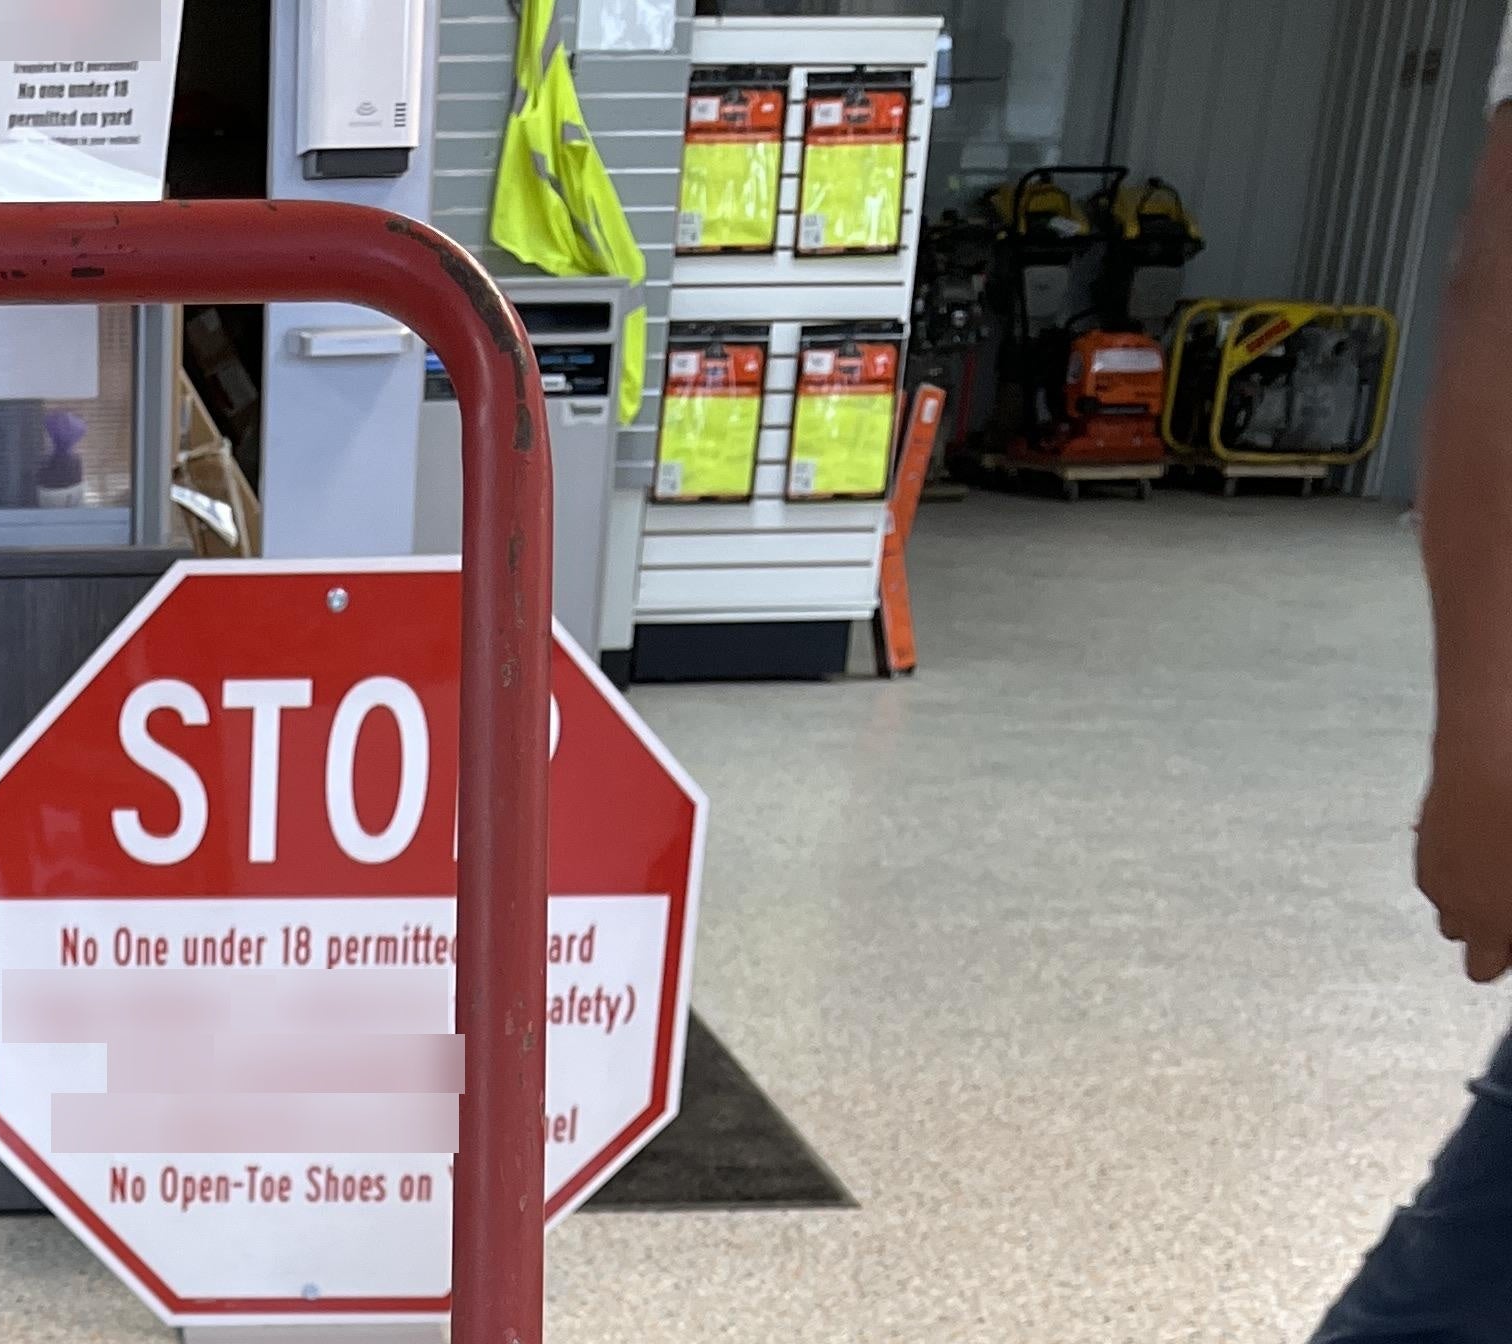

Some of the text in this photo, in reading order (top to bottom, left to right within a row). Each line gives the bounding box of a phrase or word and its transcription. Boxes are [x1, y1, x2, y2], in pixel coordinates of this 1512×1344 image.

[18, 83, 36, 99] No
[39, 84, 64, 98] one
[68, 81, 110, 98] under
[8, 108, 133, 129] permitted on yard
[111, 676, 561, 865] STO
[61, 926, 97, 966] No
[114, 926, 169, 966] One
[183, 926, 266, 966] under
[282, 925, 312, 966] 18
[547, 923, 596, 964] ard
[546, 984, 636, 1034] afety)
[110, 1164, 433, 1212] No Open-Toe Shoes on
